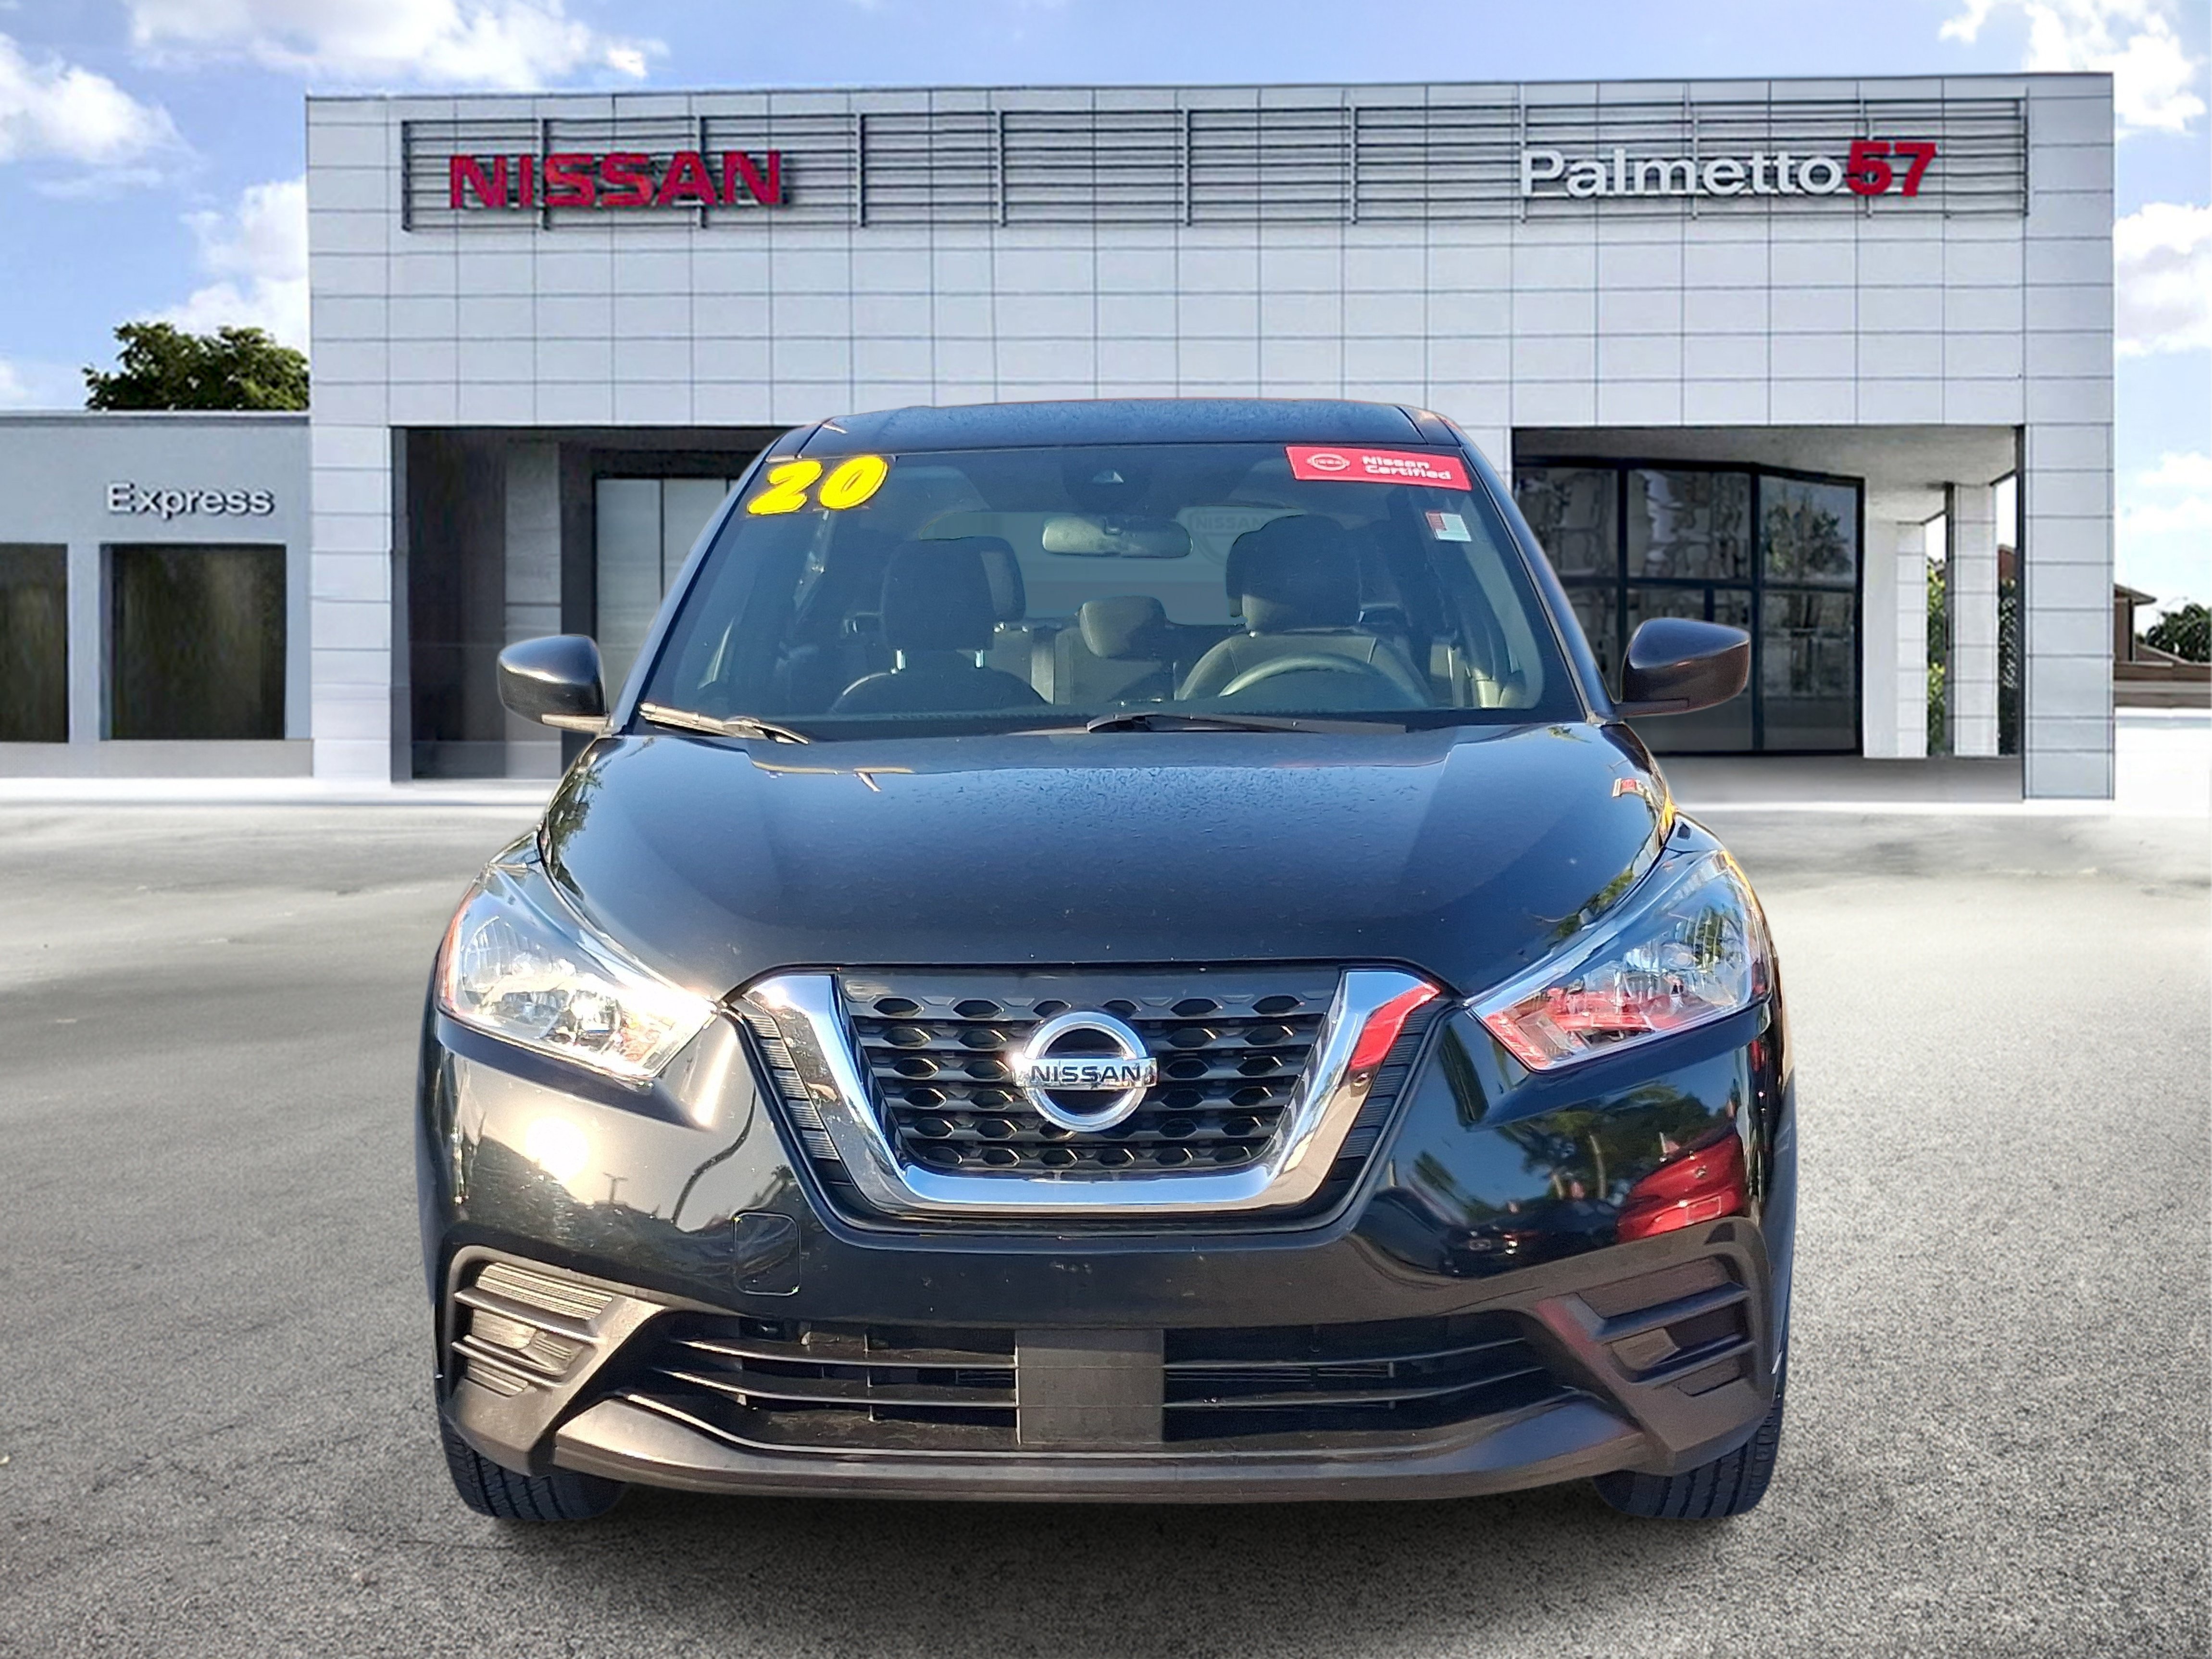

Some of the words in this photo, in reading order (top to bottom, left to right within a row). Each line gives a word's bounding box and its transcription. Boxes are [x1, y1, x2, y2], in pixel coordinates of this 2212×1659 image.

[449, 150, 782, 209] NISSAN
[1361, 455, 1431, 469] Nissan
[1365, 464, 1452, 480] Certified
[747, 454, 888, 515] 20
[107, 483, 275, 520] Express
[1030, 1065, 1140, 1083] NISSAN
